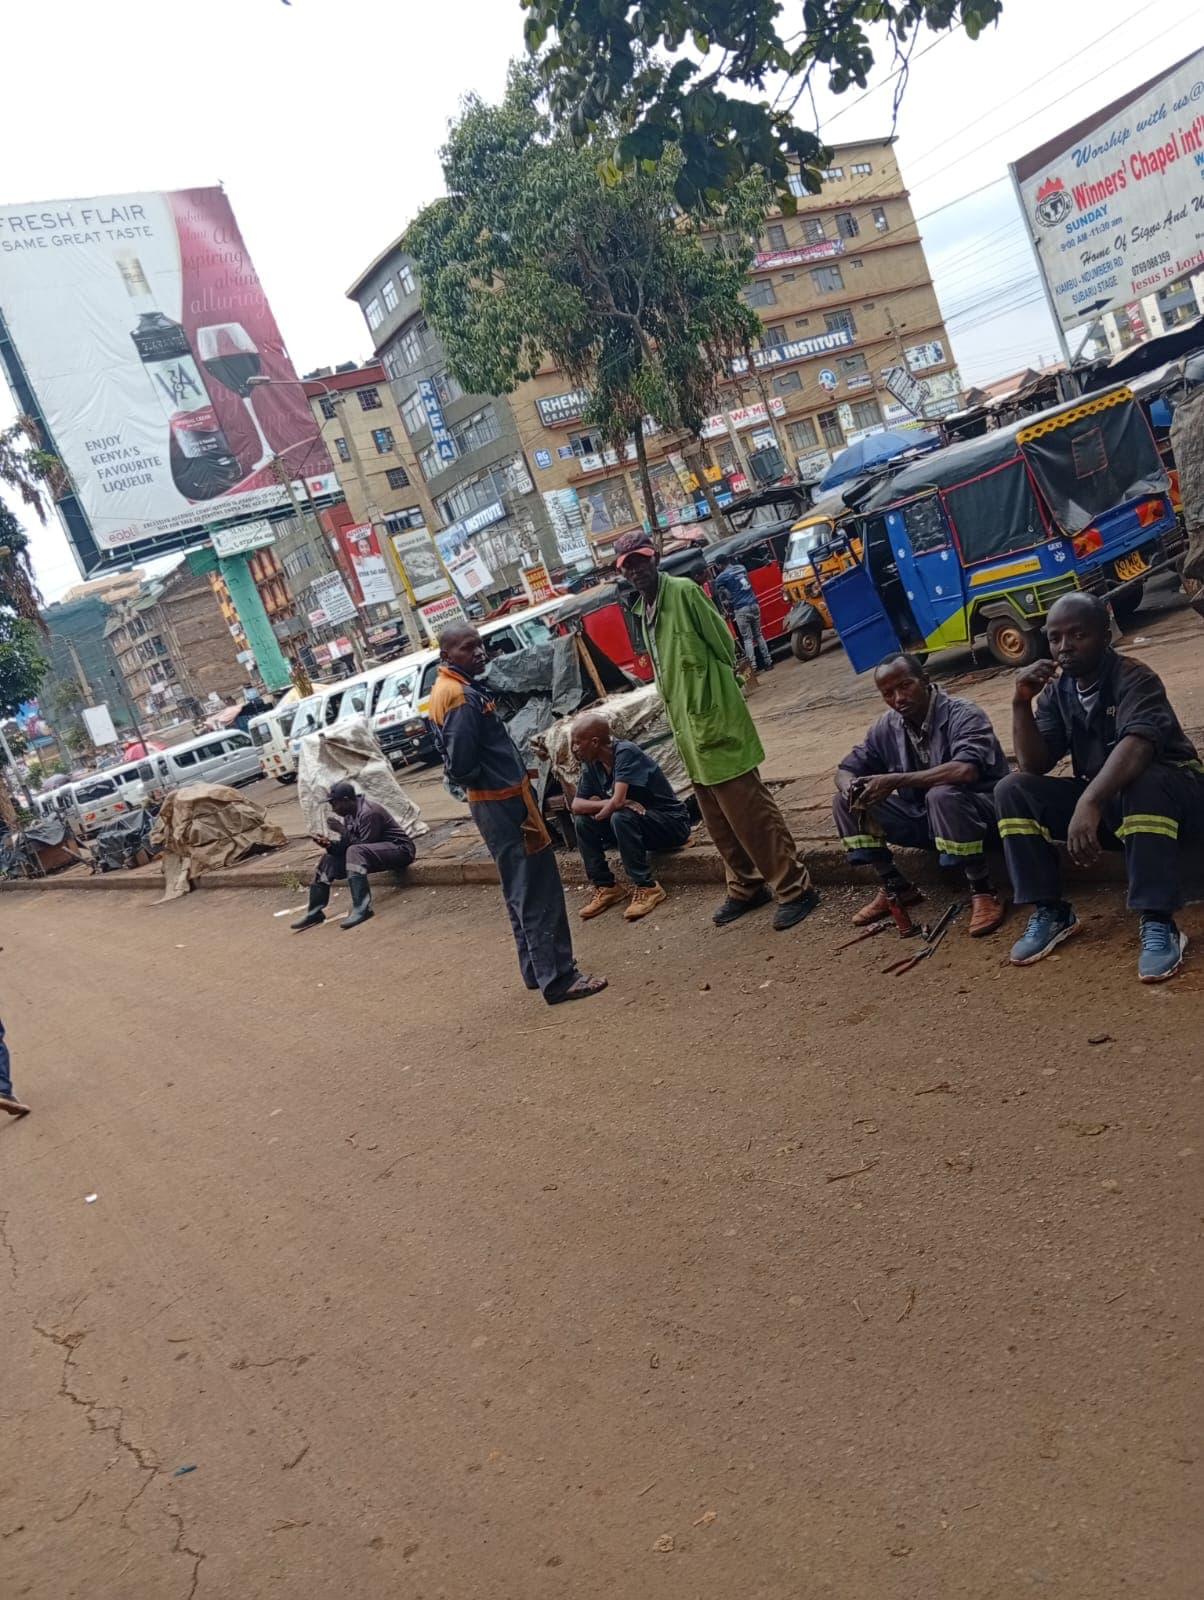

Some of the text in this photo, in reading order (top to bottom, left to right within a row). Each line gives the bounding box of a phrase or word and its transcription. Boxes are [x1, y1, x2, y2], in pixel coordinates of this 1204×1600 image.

[1072, 128, 1130, 168] Worship
[1137, 103, 1167, 132] with
[1072, 160, 1127, 212] Winners'
[1131, 133, 1180, 181] Chapel
[81, 204, 147, 225] FLAIR
[1065, 205, 1108, 234] SUNDAY
[2, 226, 154, 252] SAME GREAT TASTE
[1080, 246, 1112, 267] Home
[1114, 234, 1127, 252] Of
[1131, 220, 1162, 243] Signs
[1162, 204, 1188, 230] And
[1097, 275, 1120, 295] STAGE
[1131, 271, 1162, 293] Jesus
[1162, 263, 1175, 278] Is
[783, 332, 848, 359] INSTITUTE
[540, 389, 590, 413] RHEMA
[419, 382, 453, 458] RHEMA
[731, 410, 750, 421] WA
[85, 435, 121, 451] ENJOY
[91, 446, 141, 465] KENYA'S
[97, 456, 162, 479] FAVOURITE
[102, 473, 154, 493] LIQUEUR
[465, 502, 502, 531] INSTITUTE
